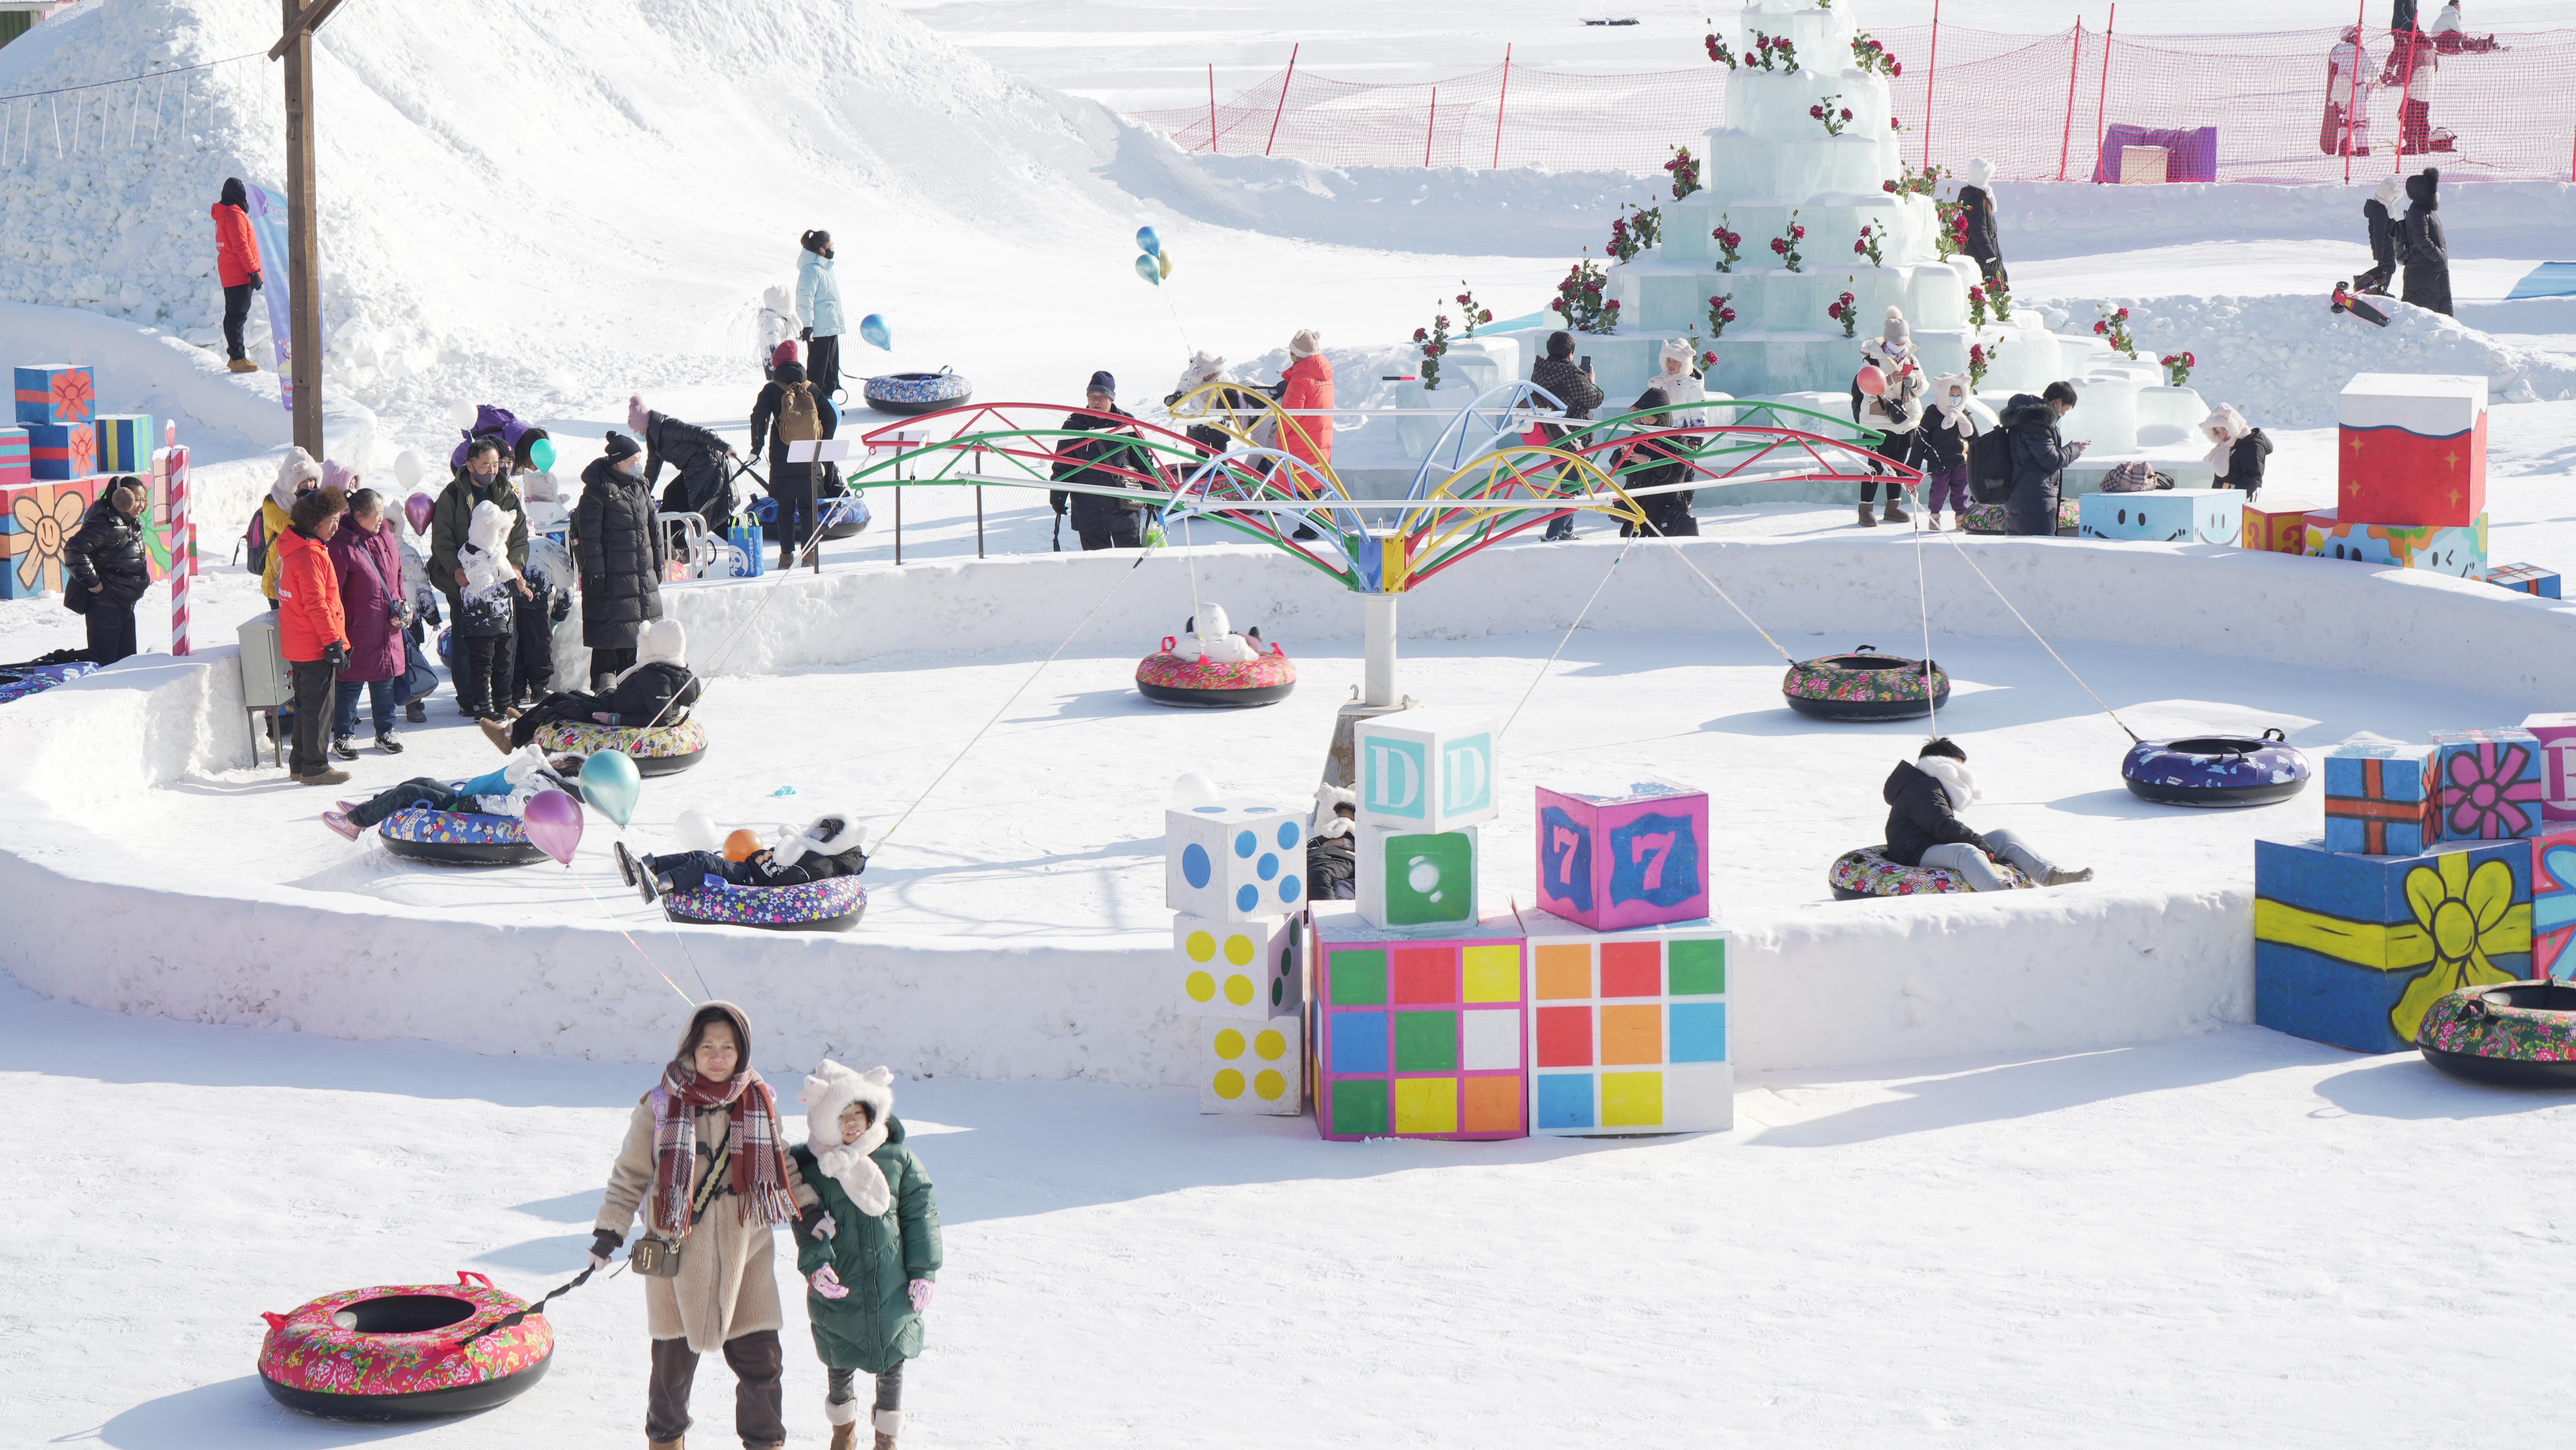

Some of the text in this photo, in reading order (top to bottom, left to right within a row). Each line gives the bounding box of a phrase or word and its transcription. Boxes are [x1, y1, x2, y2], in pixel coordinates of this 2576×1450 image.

[1370, 746, 1419, 808] D
[1446, 747, 1485, 810] D
[332, 814, 346, 829] SKATE
[1554, 826, 1579, 885] 7
[1632, 831, 1676, 890] 7
